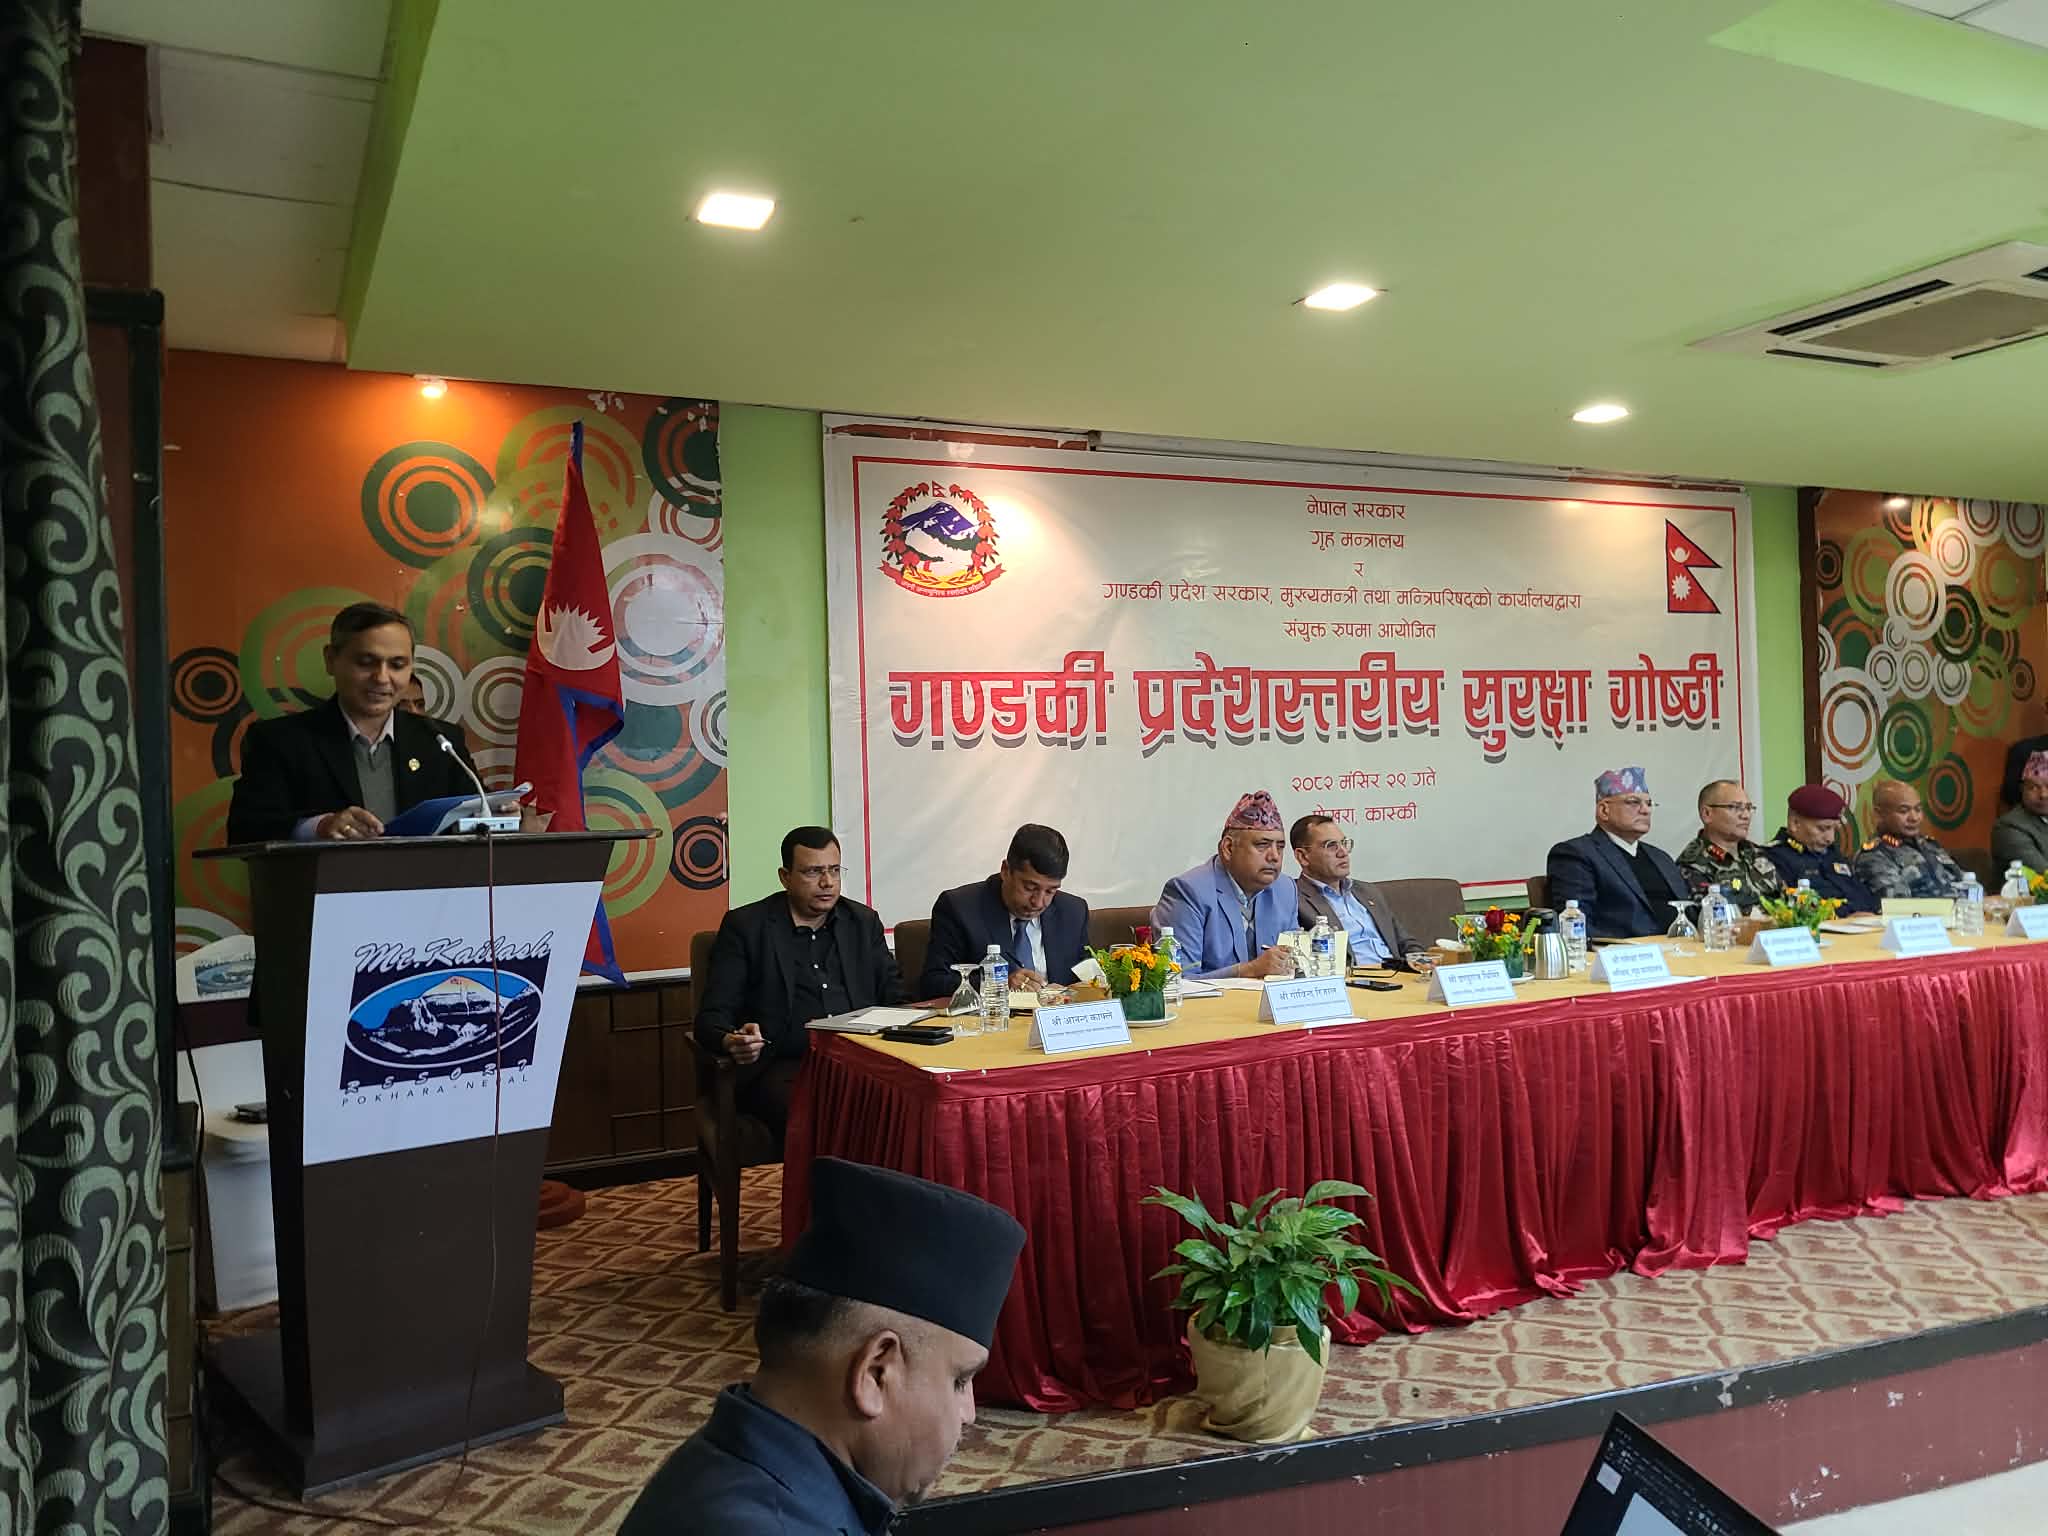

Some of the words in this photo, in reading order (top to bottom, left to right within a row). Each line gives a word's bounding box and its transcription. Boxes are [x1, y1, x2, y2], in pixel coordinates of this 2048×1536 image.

[1305, 495, 1348, 517] नेपाल
[1352, 502, 1407, 520] सरकार
[1308, 530, 1335, 551] गृह
[1340, 531, 1407, 550] मन्त्रालय
[1352, 561, 1365, 577] र
[1101, 580, 1163, 601] गण्डकी
[1167, 578, 1208, 603] प्रदेश
[1212, 584, 1273, 606] सरकार,
[1279, 586, 1358, 608] मुख्यमन्त्री
[1363, 589, 1392, 606] तथा
[1496, 587, 1584, 612] कार्यालयद्वारा
[1282, 618, 1328, 643] संयुक्त
[1330, 622, 1373, 639] रुपमा
[1377, 617, 1437, 639] आयोजित
[889, 650, 1115, 746] गण्डकी
[1132, 650, 1445, 754] प्रदेशस्तरीय
[1461, 668, 1593, 760] सुरक्षा
[1607, 653, 1724, 730] गोष्ठी
[1291, 775, 1334, 793] २०८२
[1338, 770, 1381, 790] मंसिर
[1410, 766, 1437, 787] गते
[1364, 801, 1418, 822] कास्की
